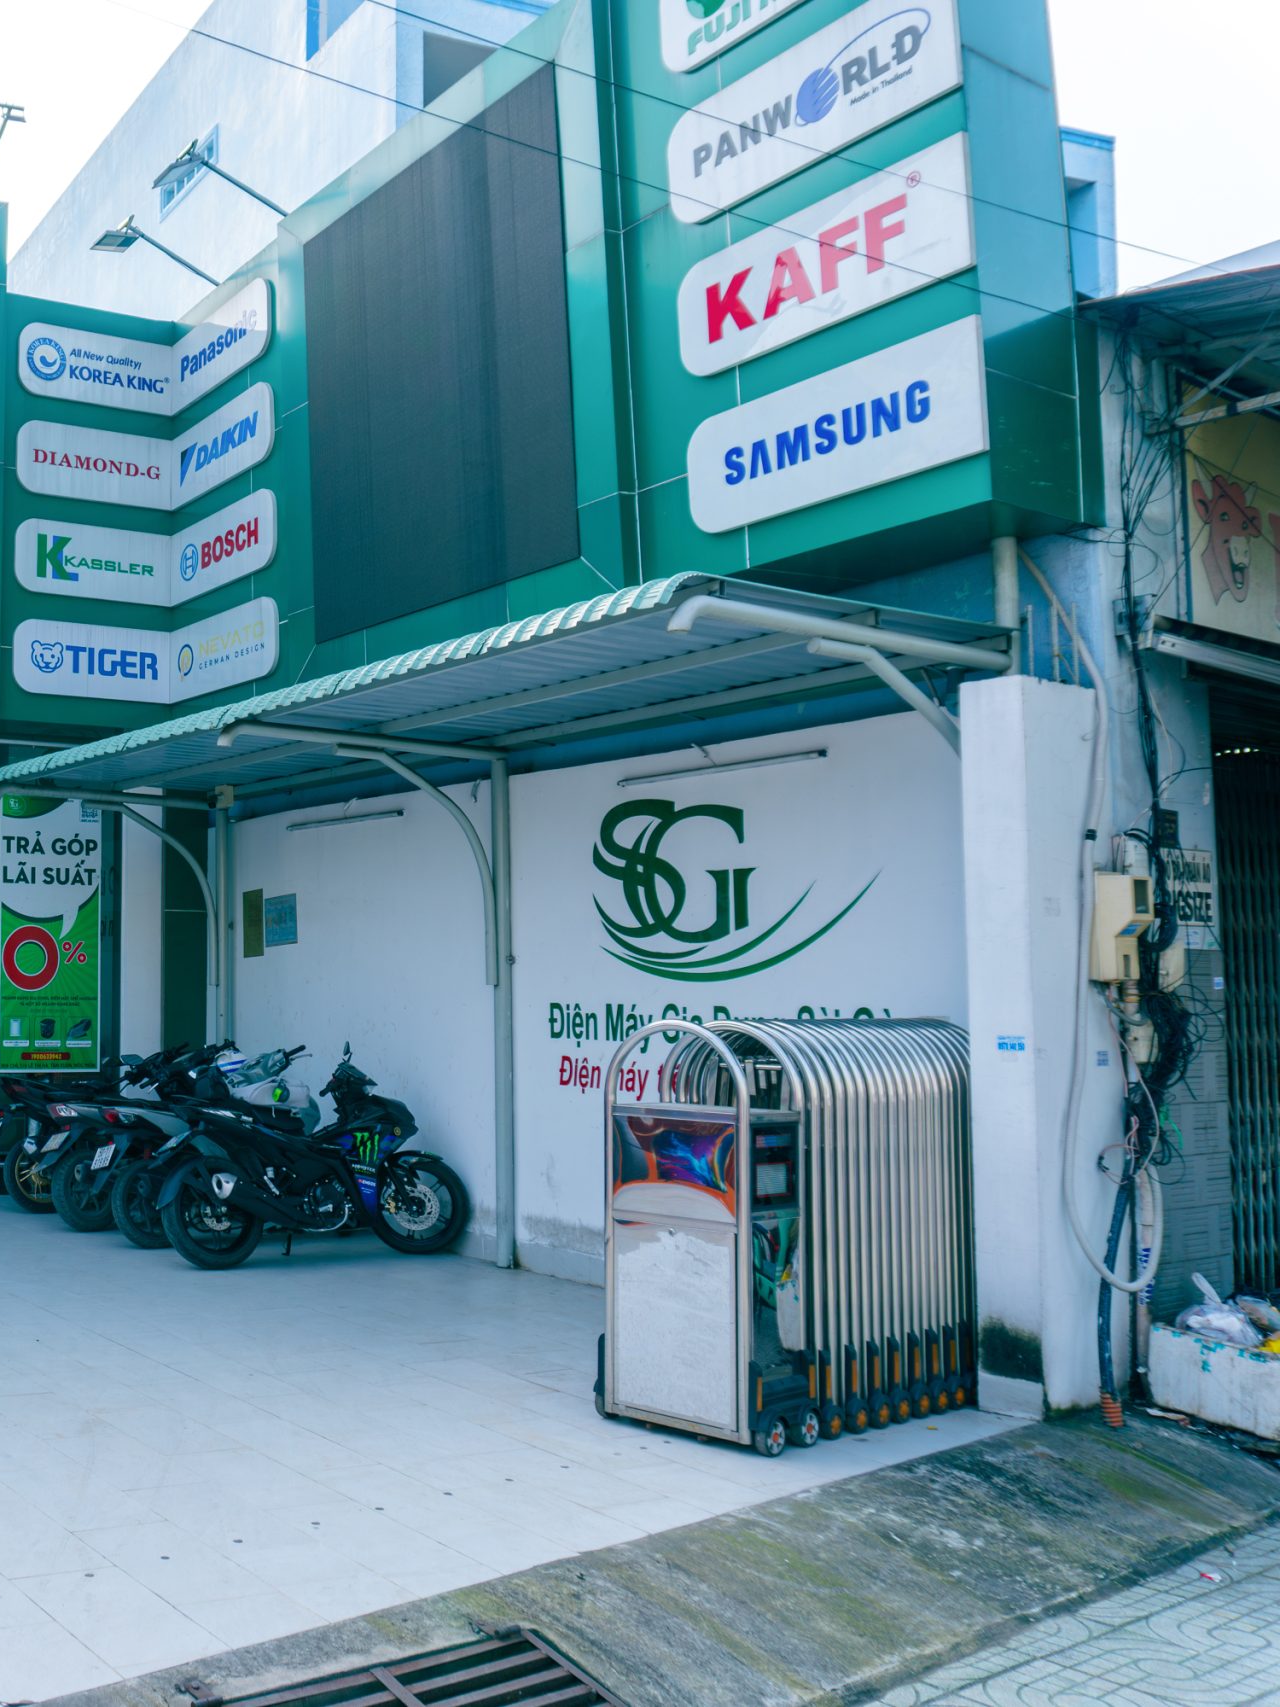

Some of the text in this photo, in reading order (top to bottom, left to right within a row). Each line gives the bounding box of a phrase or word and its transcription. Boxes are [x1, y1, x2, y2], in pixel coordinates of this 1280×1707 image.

[849, 90, 870, 106] Made
[881, 66, 913, 89] Thailand
[706, 193, 908, 344] KAFF
[69, 348, 82, 358] All
[83, 351, 104, 362] New
[180, 309, 258, 382] Panasonic
[70, 364, 124, 388] KOREA
[126, 374, 164, 394] KING
[195, 410, 258, 472] DAIKIN
[724, 379, 931, 486] SAMSUNG
[33, 448, 161, 481] DIAMOND-G
[201, 517, 259, 570] BOSCH
[64, 555, 154, 577] KASSLER
[66, 644, 159, 681] TIGER
[199, 642, 266, 671] GERMAN DESIGN
[2, 830, 98, 856] TRẢ GÓP
[2, 859, 96, 886] LÃI SUẤT
[548, 1002, 598, 1048] Điện
[559, 1055, 601, 1094] Điện
[619, 1062, 649, 1101] áy
